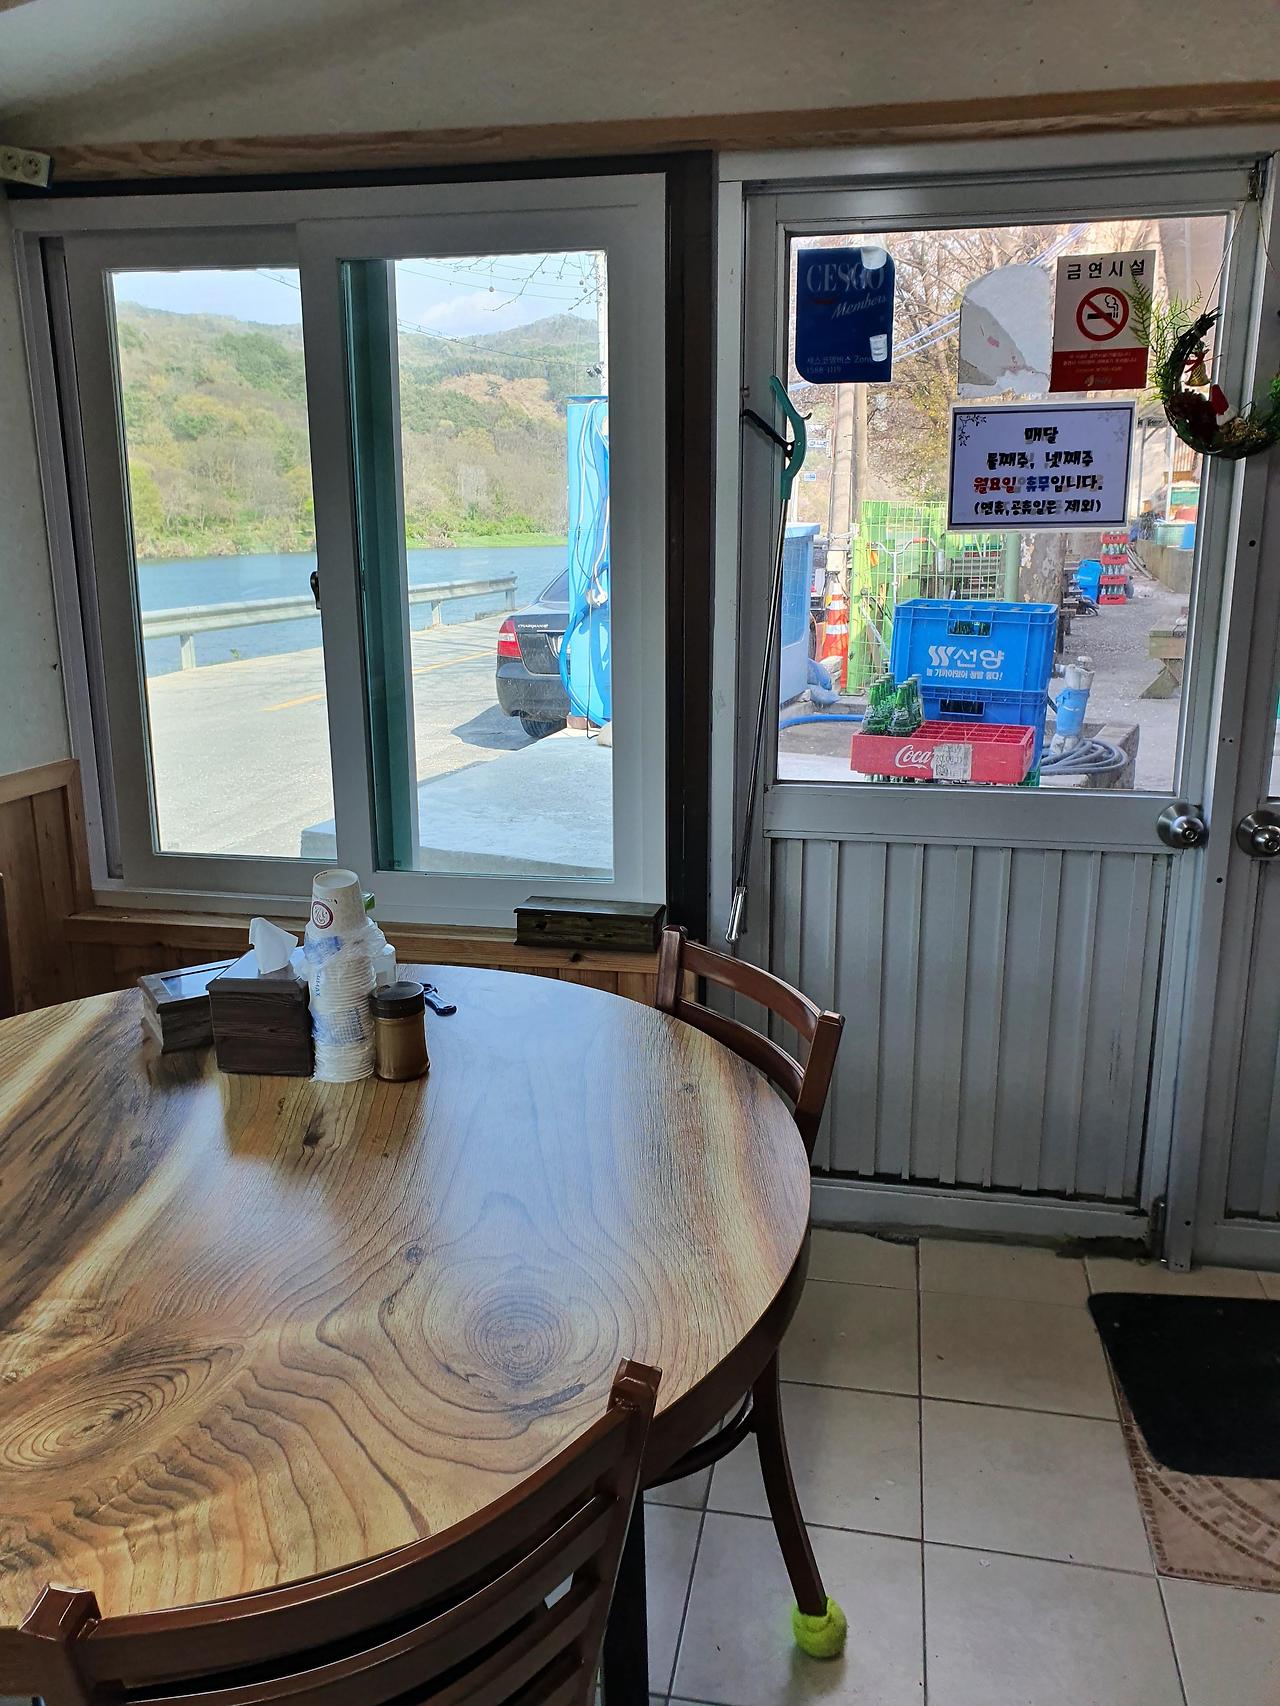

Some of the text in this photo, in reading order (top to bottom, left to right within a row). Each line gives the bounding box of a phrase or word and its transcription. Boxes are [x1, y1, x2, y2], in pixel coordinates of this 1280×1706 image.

[1067, 259, 1145, 280] 금연시설
[1024, 426, 1059, 444] 매달
[986, 450, 1094, 470] 둘째주, 넷째주
[973, 474, 1103, 494] 월요일 휴무입니다.
[1064, 498, 1102, 513] 제외)
[953, 648, 1005, 669] 선양
